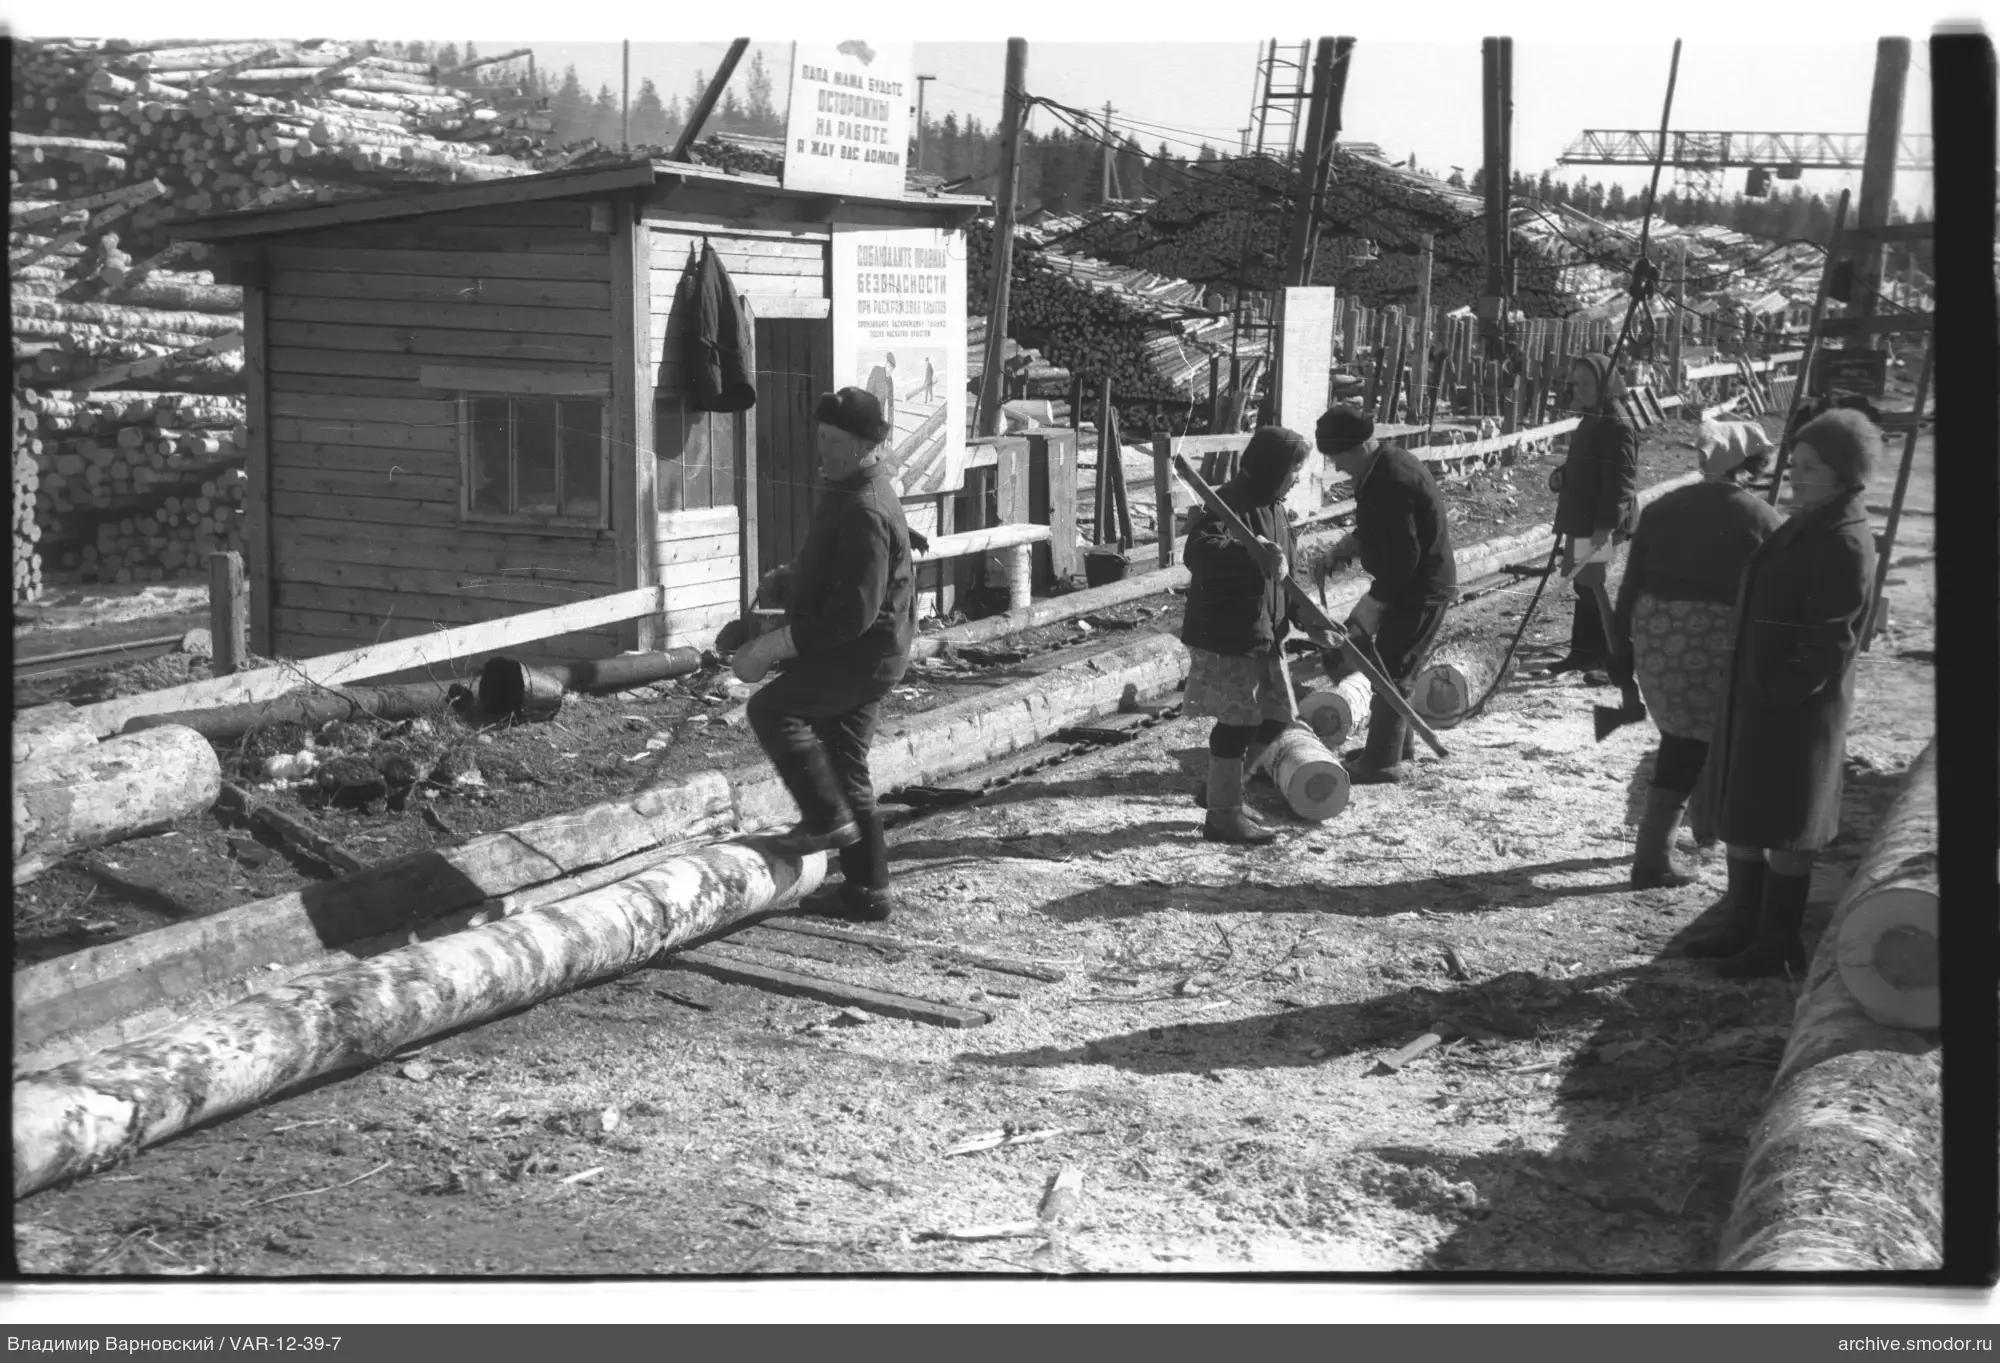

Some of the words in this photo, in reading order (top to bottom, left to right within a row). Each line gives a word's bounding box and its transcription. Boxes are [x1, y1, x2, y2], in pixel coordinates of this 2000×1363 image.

[802, 64, 828, 83] ПАПА
[833, 71, 863, 89] МАМА
[868, 77, 903, 97] БУДЬТЕ
[816, 117, 832, 137] НА
[837, 120, 888, 145] РАБОТЕ
[796, 138, 805, 154] Я
[810, 140, 835, 158] ЖДУ
[840, 145, 860, 161] ВАС
[857, 273, 947, 295] БЕЗОПАСНОСТИ
